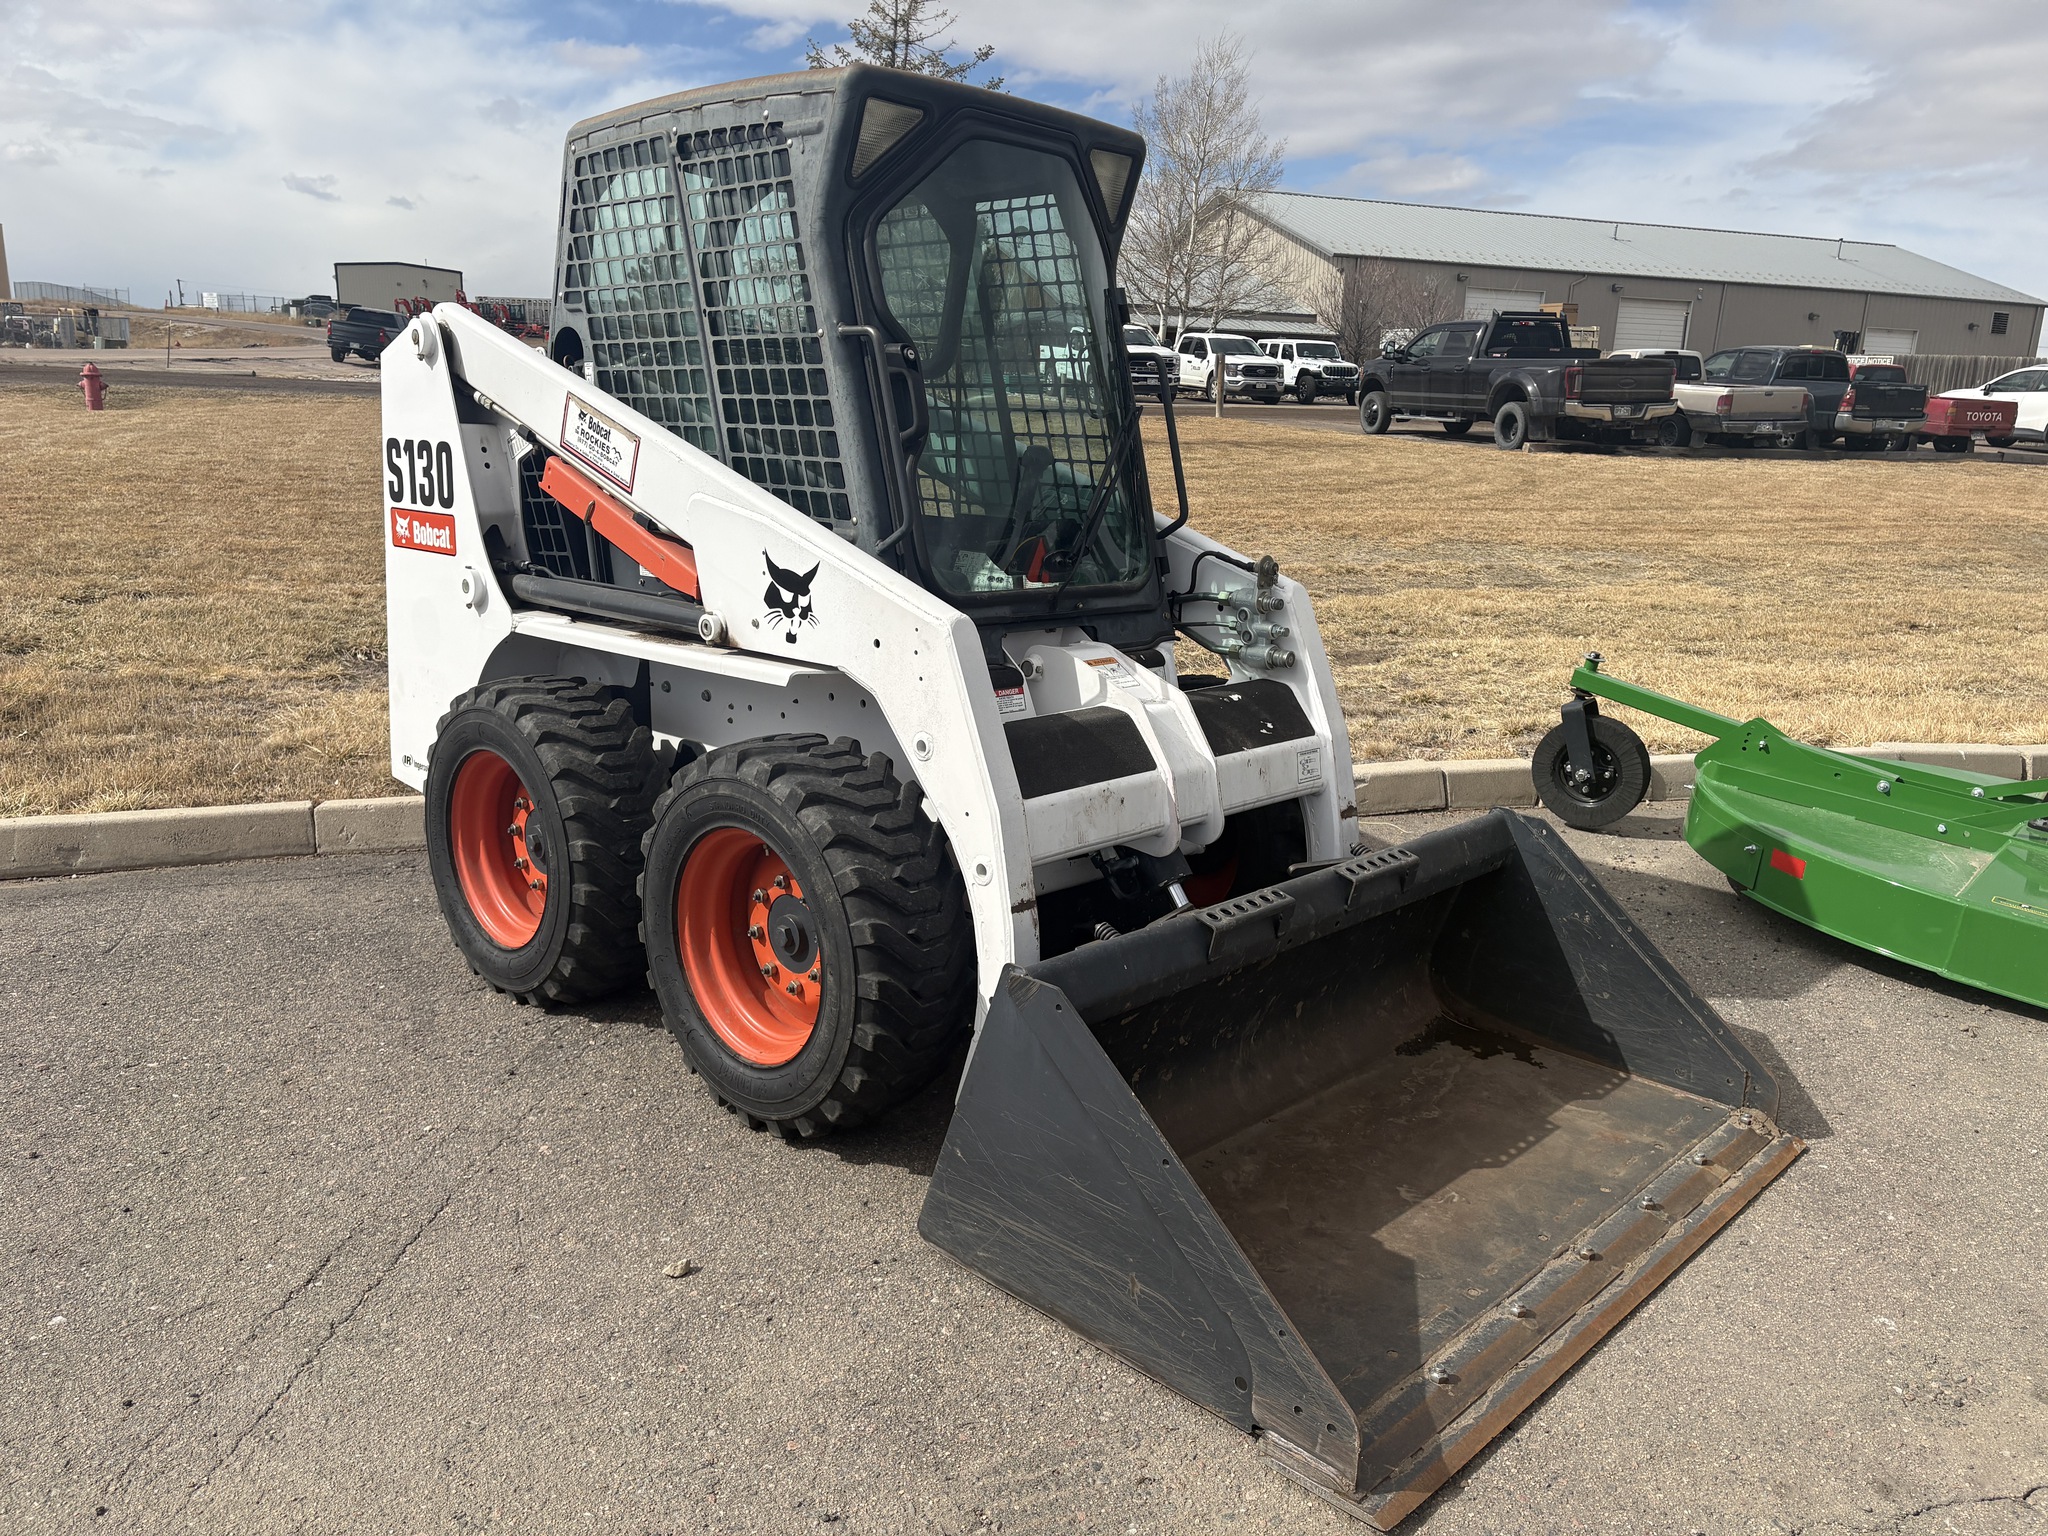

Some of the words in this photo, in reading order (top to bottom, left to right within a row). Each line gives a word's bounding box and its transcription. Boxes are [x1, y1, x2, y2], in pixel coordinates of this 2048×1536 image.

[588, 416, 611, 443] Bobcat
[1966, 411, 2003, 422] TOYOTA
[580, 428, 610, 455] ROCKIES
[386, 437, 455, 509] S130
[412, 520, 451, 549] Bobcat
[998, 688, 1020, 697] DANGER
[709, 802, 747, 815] STANDARD
[750, 809, 770, 827] DUTY
